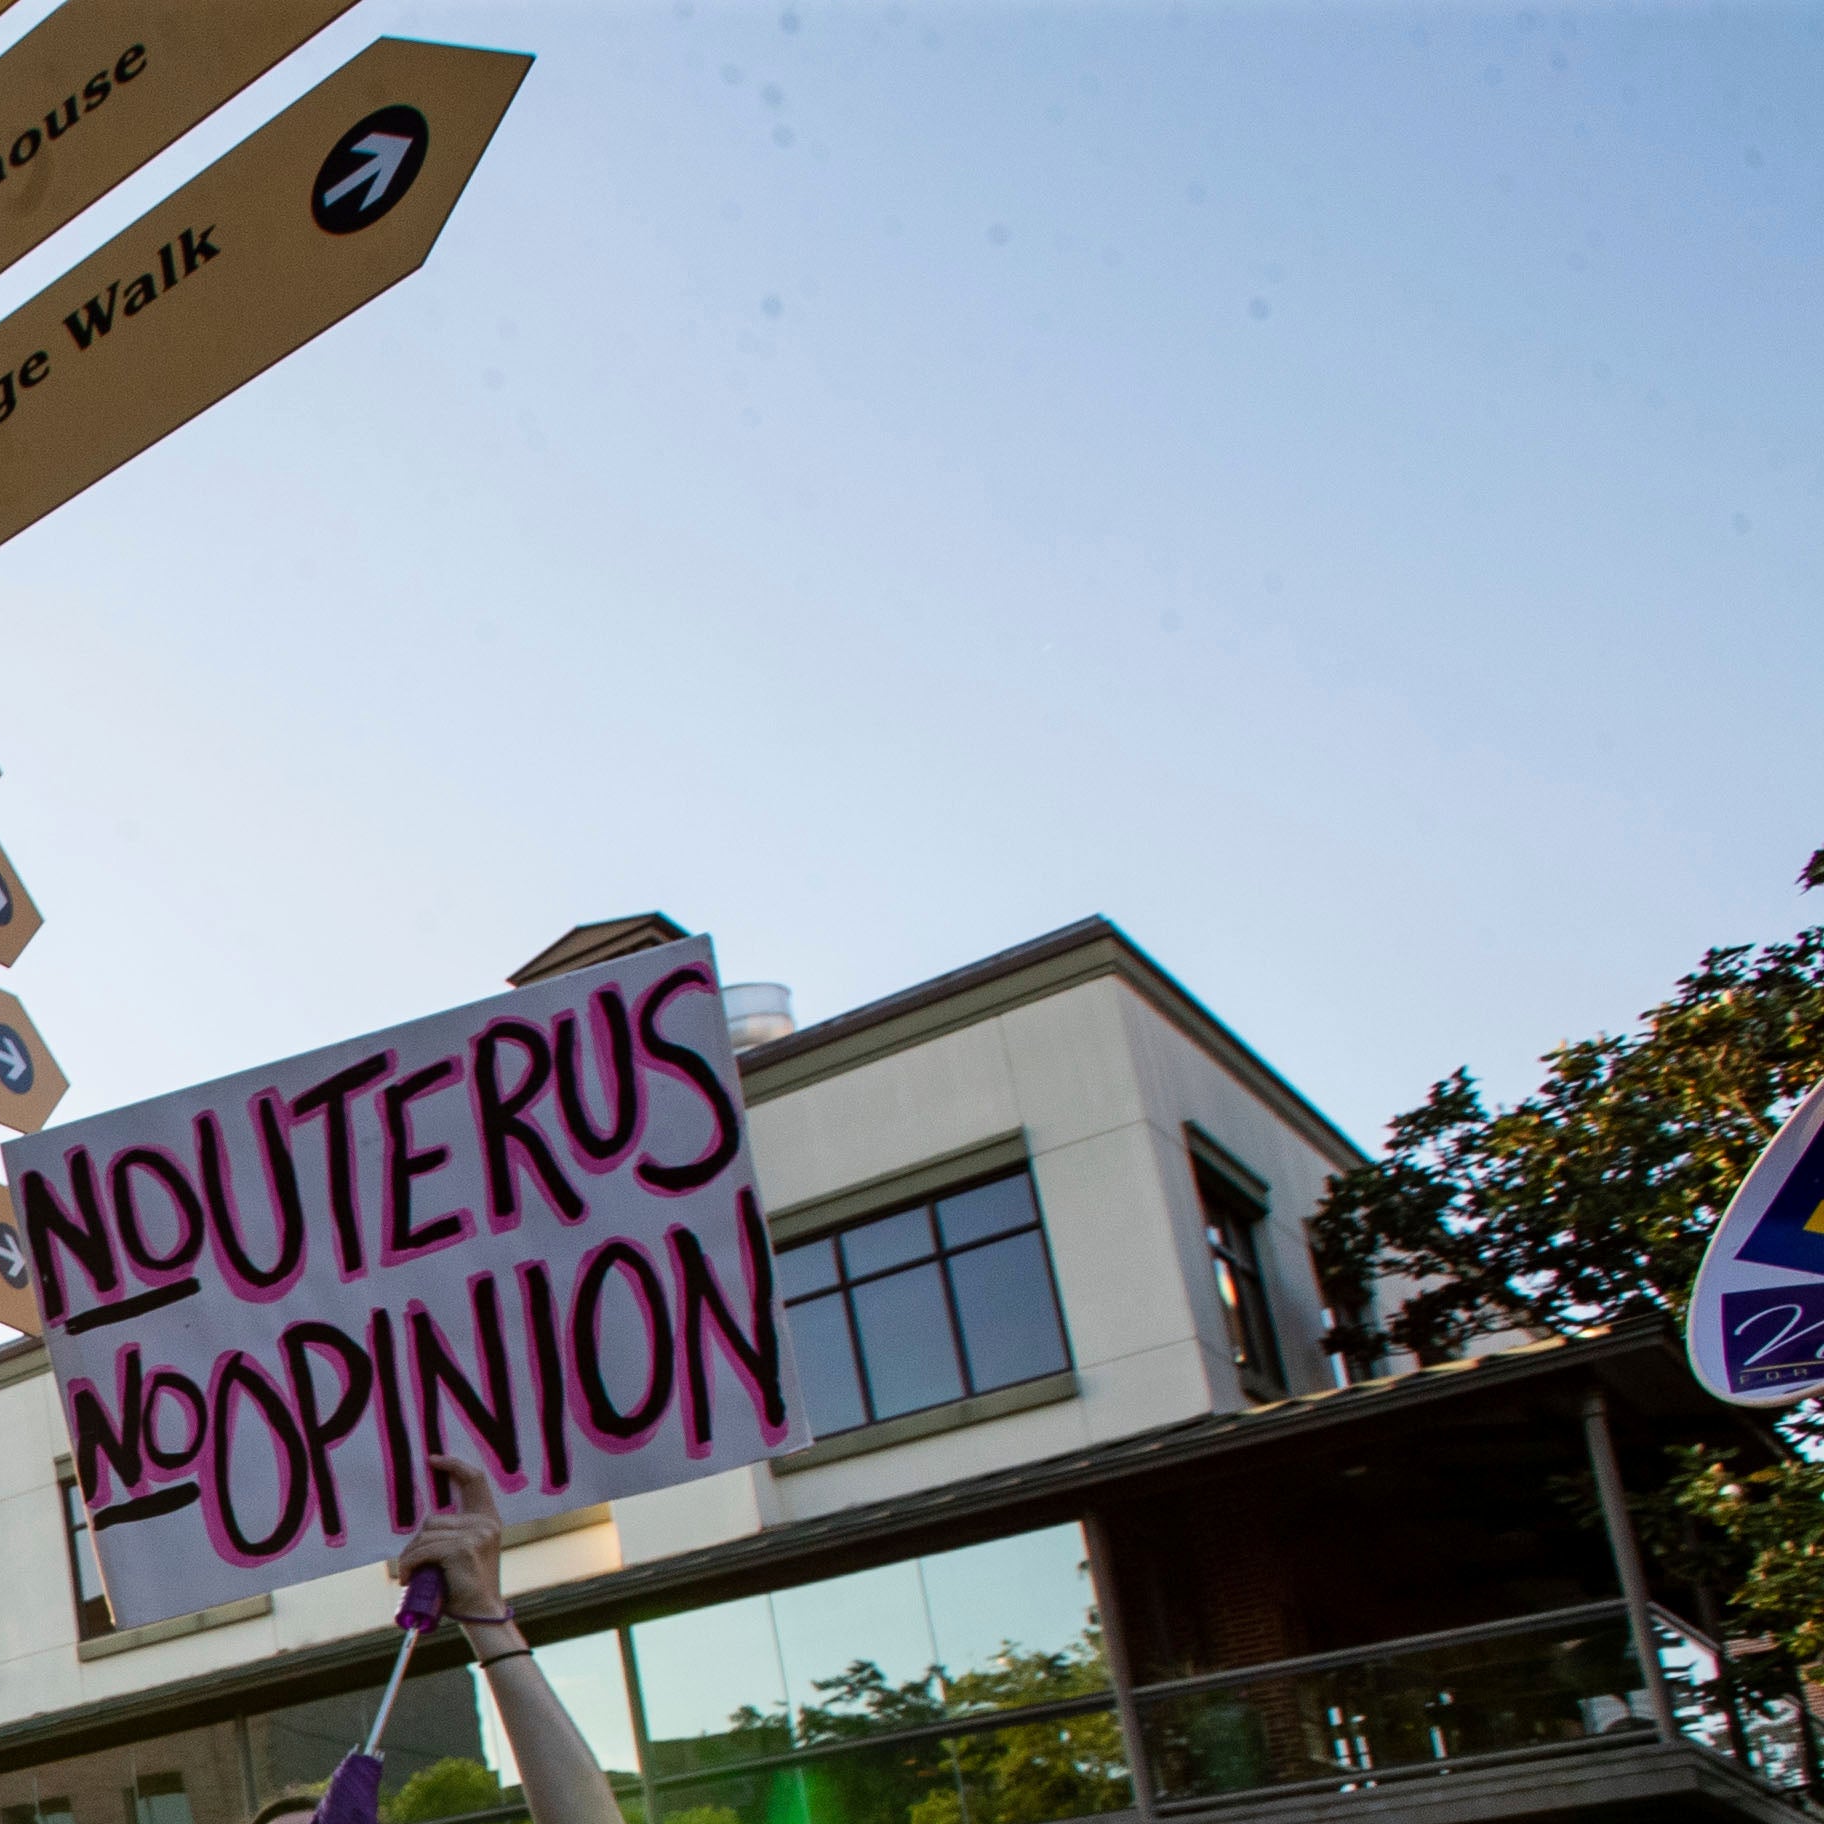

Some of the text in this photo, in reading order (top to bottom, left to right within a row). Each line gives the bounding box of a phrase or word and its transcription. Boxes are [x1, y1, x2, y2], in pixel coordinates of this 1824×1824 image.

[62, 217, 224, 352] Walk
[19, 961, 741, 1332] NO UTERUS
[68, 1186, 789, 1568] NO OPINION
